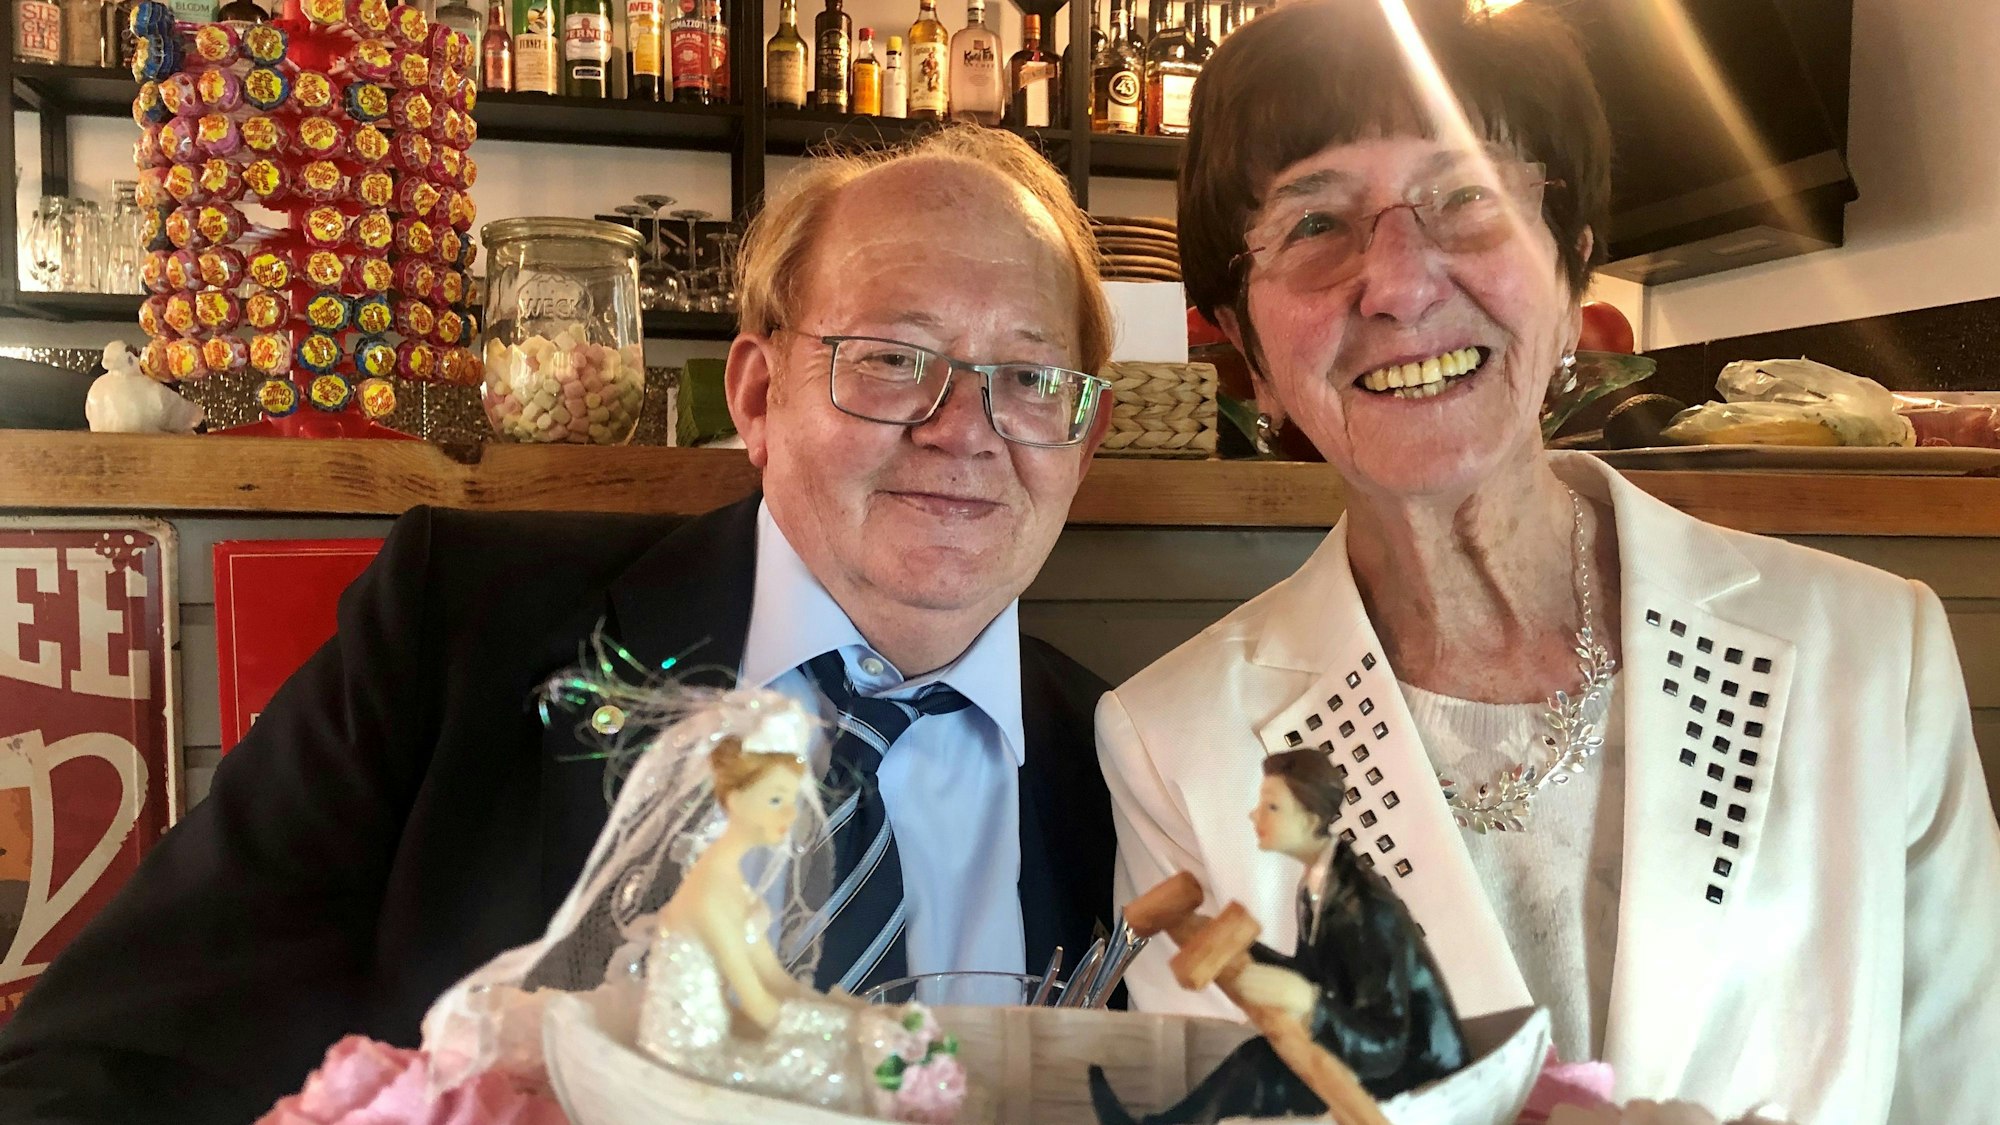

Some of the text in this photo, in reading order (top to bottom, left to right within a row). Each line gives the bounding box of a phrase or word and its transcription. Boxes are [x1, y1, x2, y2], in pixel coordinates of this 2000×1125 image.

[22, 3, 58, 21] SIE
[175, 2, 209, 12] BLOOM
[1115, 78, 1135, 96] 43
